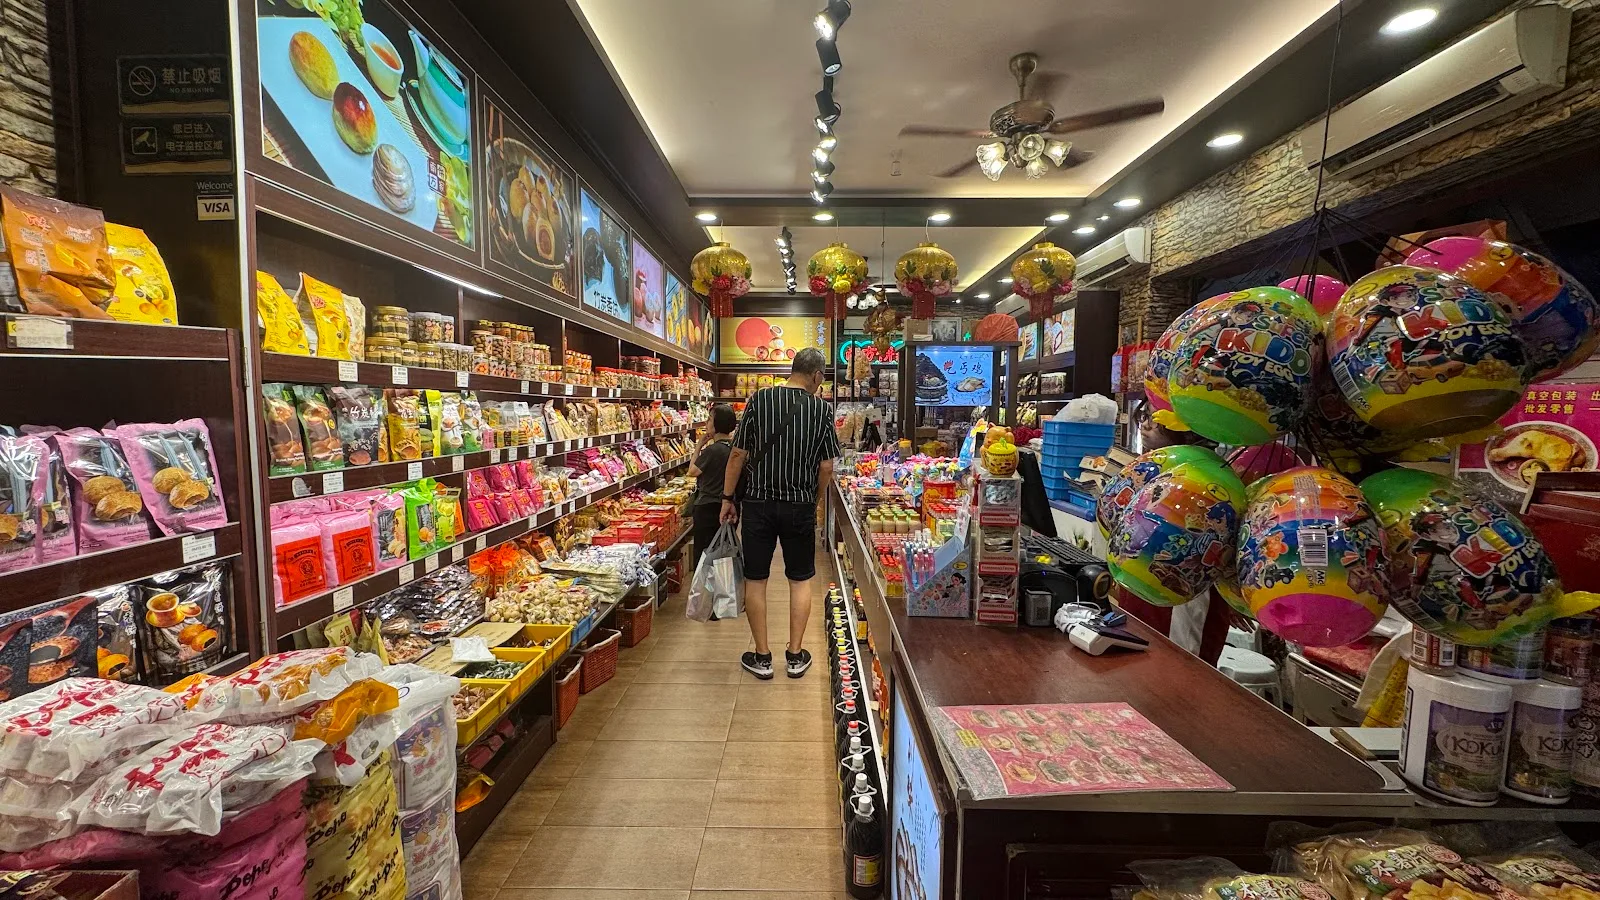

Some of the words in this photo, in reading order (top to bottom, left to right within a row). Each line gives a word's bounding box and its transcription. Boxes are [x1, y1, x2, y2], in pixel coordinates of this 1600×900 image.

[162, 67, 222, 85] 禁止吸烟
[172, 123, 214, 134] 您已进入
[165, 140, 224, 151] 电子监控区域
[196, 181, 234, 190] Welcome
[202, 203, 230, 213] VISA
[1437, 324, 1474, 343] TOY
[1215, 327, 1312, 377] KIDO
[1230, 352, 1265, 367] TOY
[1264, 360, 1294, 382] EGG
[1526, 390, 1577, 401] 真空包装
[1524, 403, 1575, 414] 批发零售
[1498, 552, 1525, 577] TOY
[1538, 736, 1576, 754] KOK
